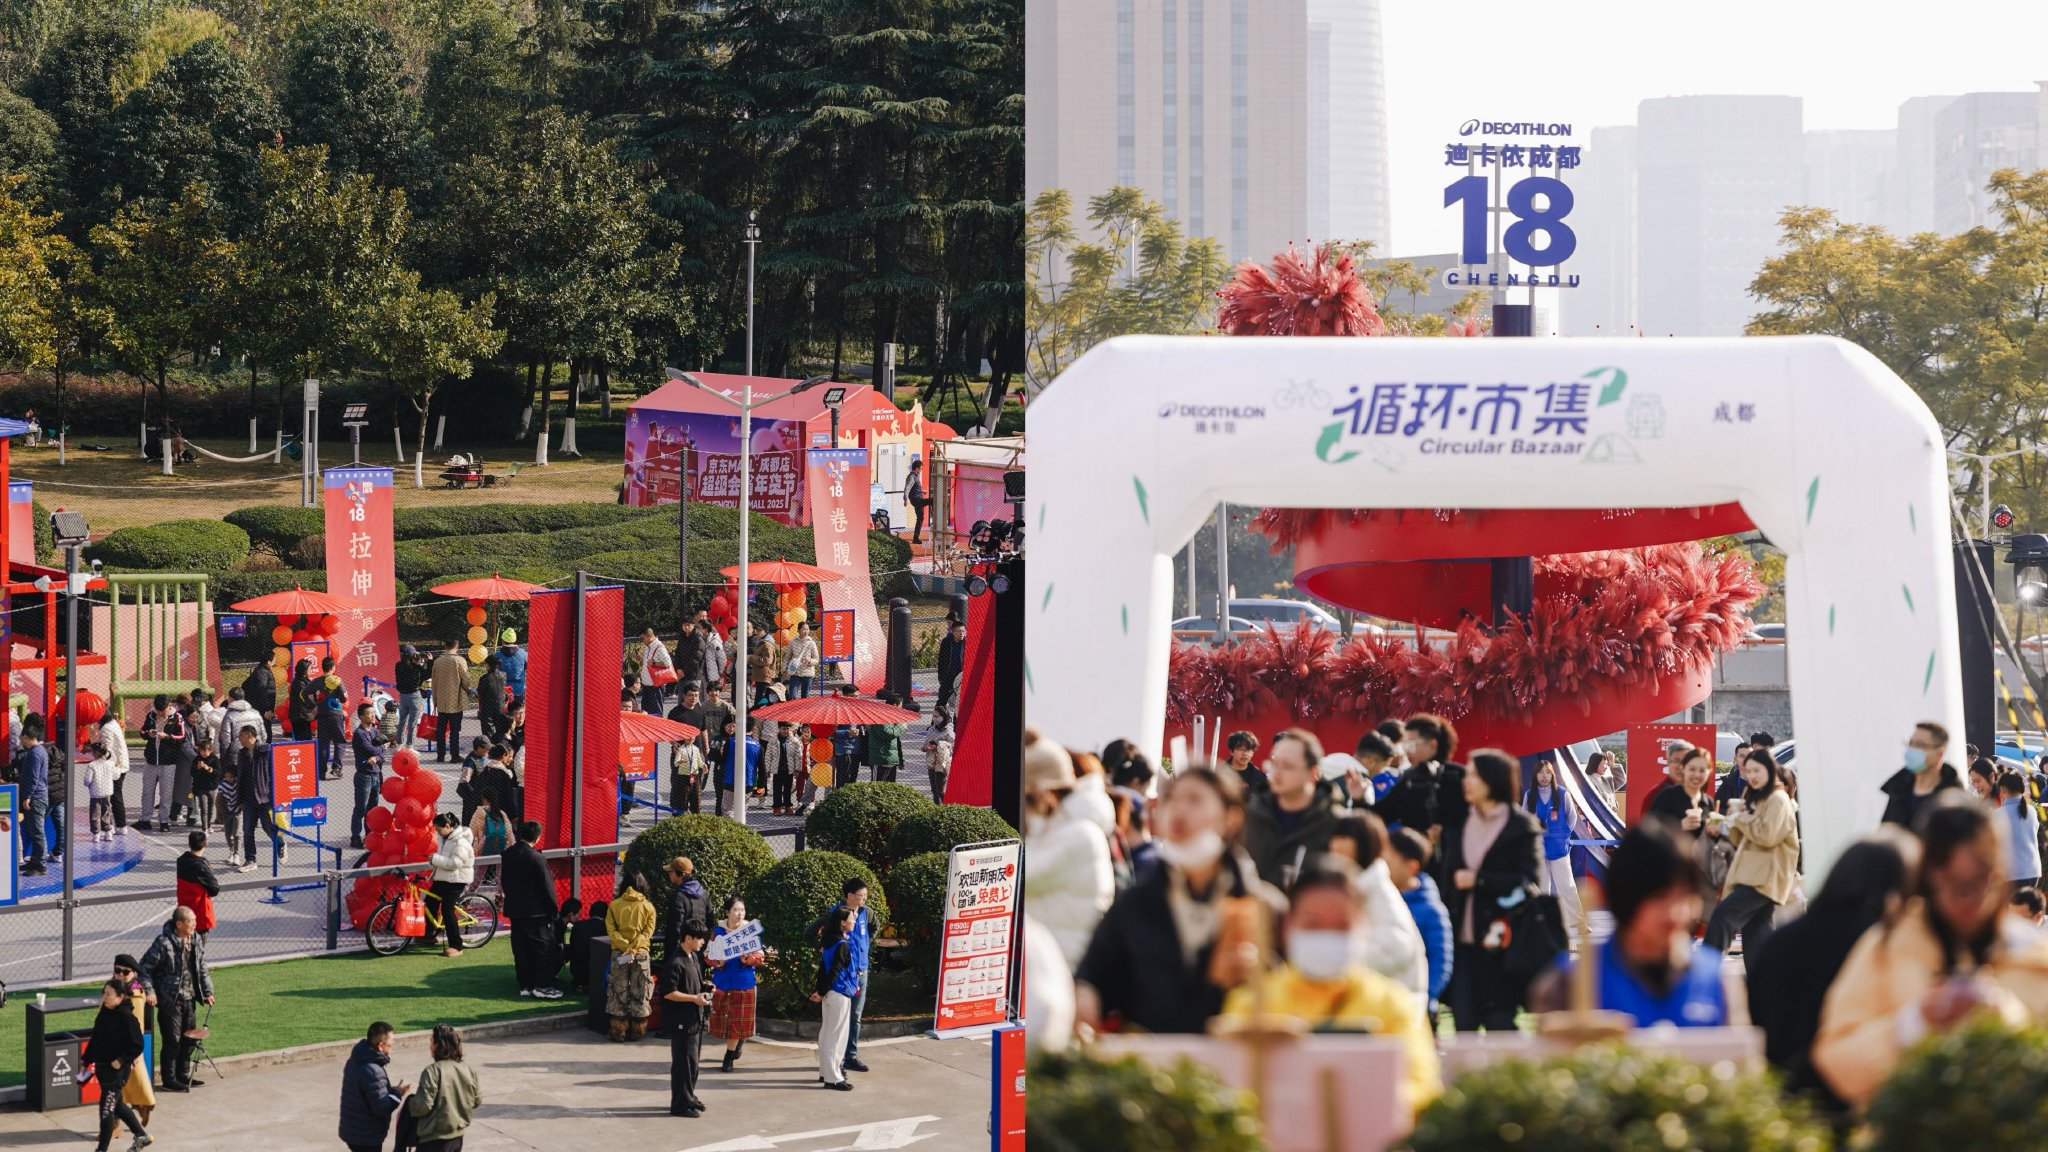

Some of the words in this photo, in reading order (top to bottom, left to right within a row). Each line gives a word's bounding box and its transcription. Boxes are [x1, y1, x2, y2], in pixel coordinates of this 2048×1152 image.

[1482, 121, 1572, 136] DECATHLON
[1444, 176, 1577, 267] 18
[1447, 272, 1581, 288] CHENGDU
[1180, 405, 1266, 418] DECATHLON
[1332, 383, 1592, 436] 循环市集
[1712, 402, 1757, 424] 成都
[1419, 438, 1505, 455] Circular
[1511, 438, 1586, 455] Bazaar
[829, 484, 844, 498] 18
[767, 499, 784, 509] 2025
[348, 508, 365, 522] 18
[724, 940, 758, 957] 都是宝贝
